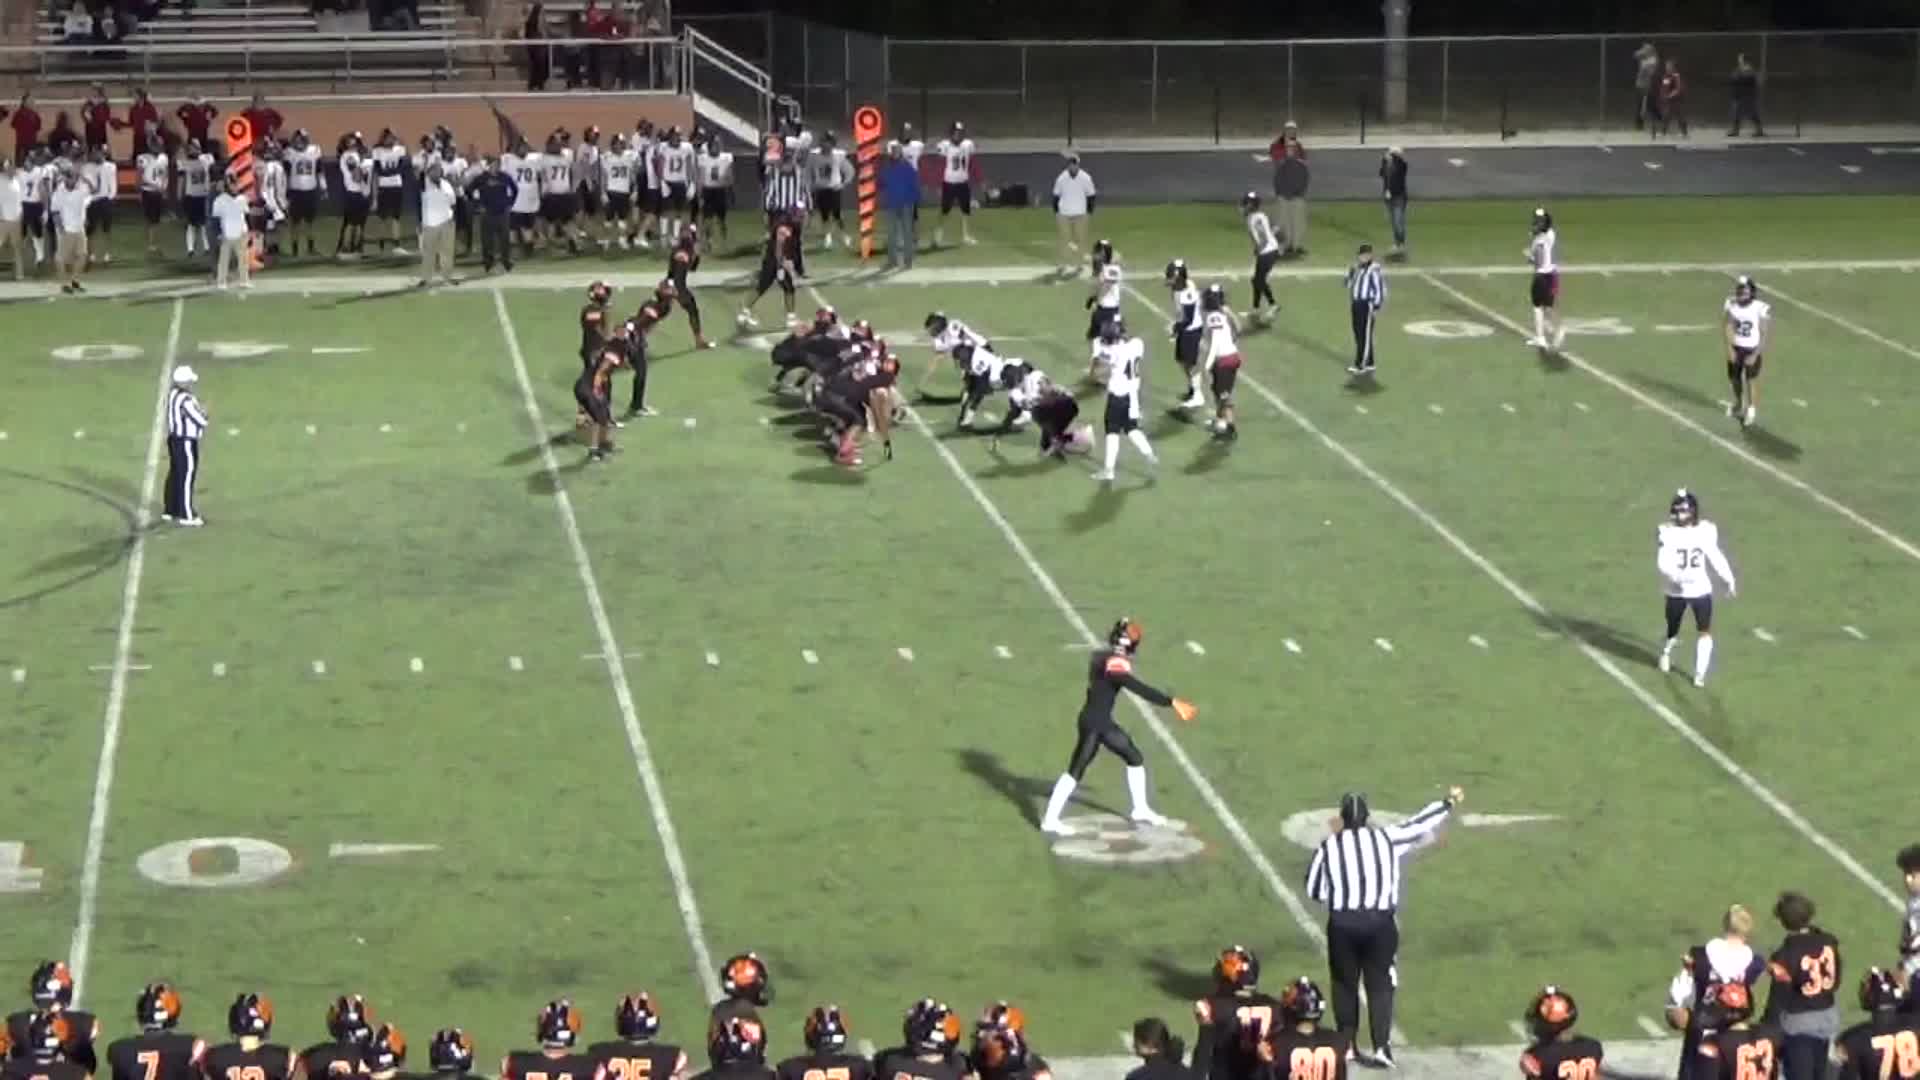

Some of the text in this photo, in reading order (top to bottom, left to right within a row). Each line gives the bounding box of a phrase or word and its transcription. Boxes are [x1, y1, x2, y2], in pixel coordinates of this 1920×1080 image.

[516, 167, 532, 182] 70
[1676, 546, 1704, 571] 32
[1801, 945, 1836, 996] 33
[137, 1051, 159, 1080] 7
[1290, 1046, 1336, 1080] 80
[1736, 1038, 1773, 1080] 63
[1871, 1030, 1920, 1080] 78
